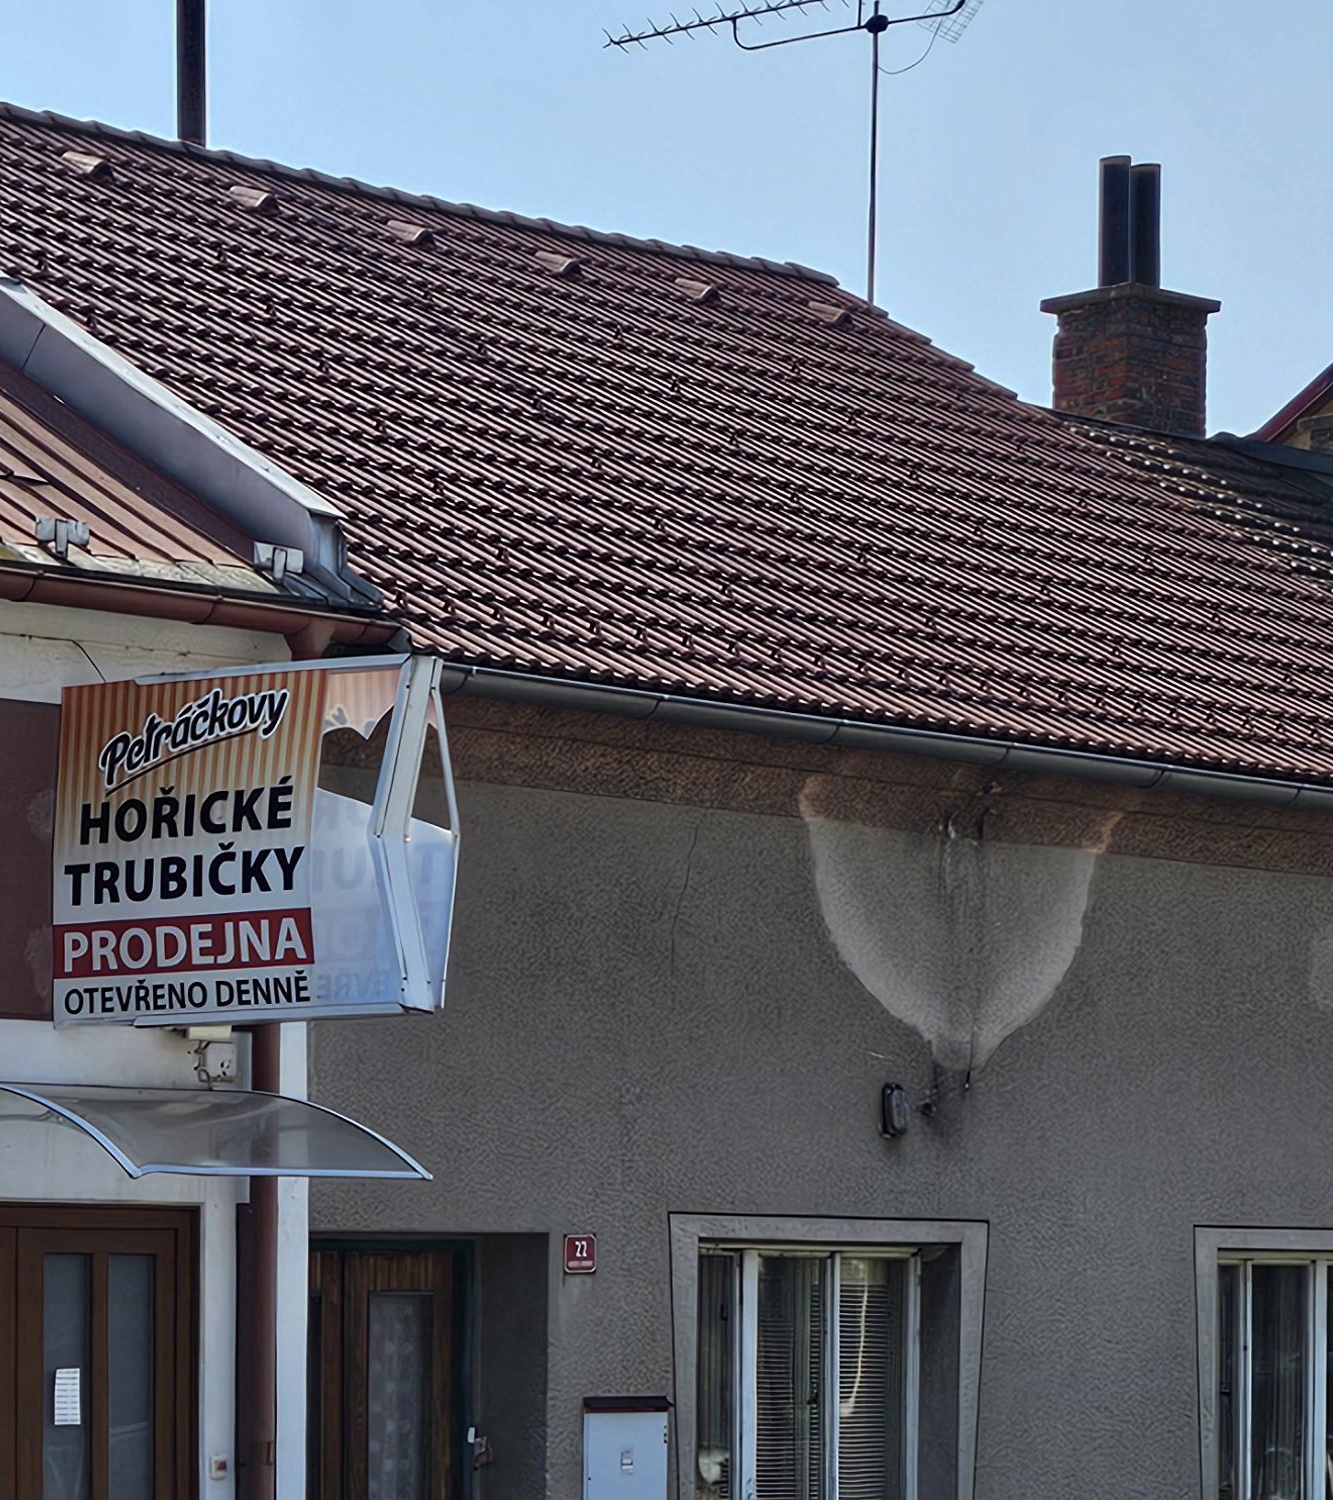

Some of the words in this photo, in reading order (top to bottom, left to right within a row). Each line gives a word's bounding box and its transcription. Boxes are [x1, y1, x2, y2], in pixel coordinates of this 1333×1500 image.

[99, 688, 289, 787] Petráčkovy
[80, 776, 294, 845] HOŘICKÉ
[64, 842, 305, 906] TRUBIČKY
[63, 917, 307, 973] PRODEJNA
[64, 979, 208, 1015] OTEVŘENO
[217, 970, 311, 1007] DENNĚ
